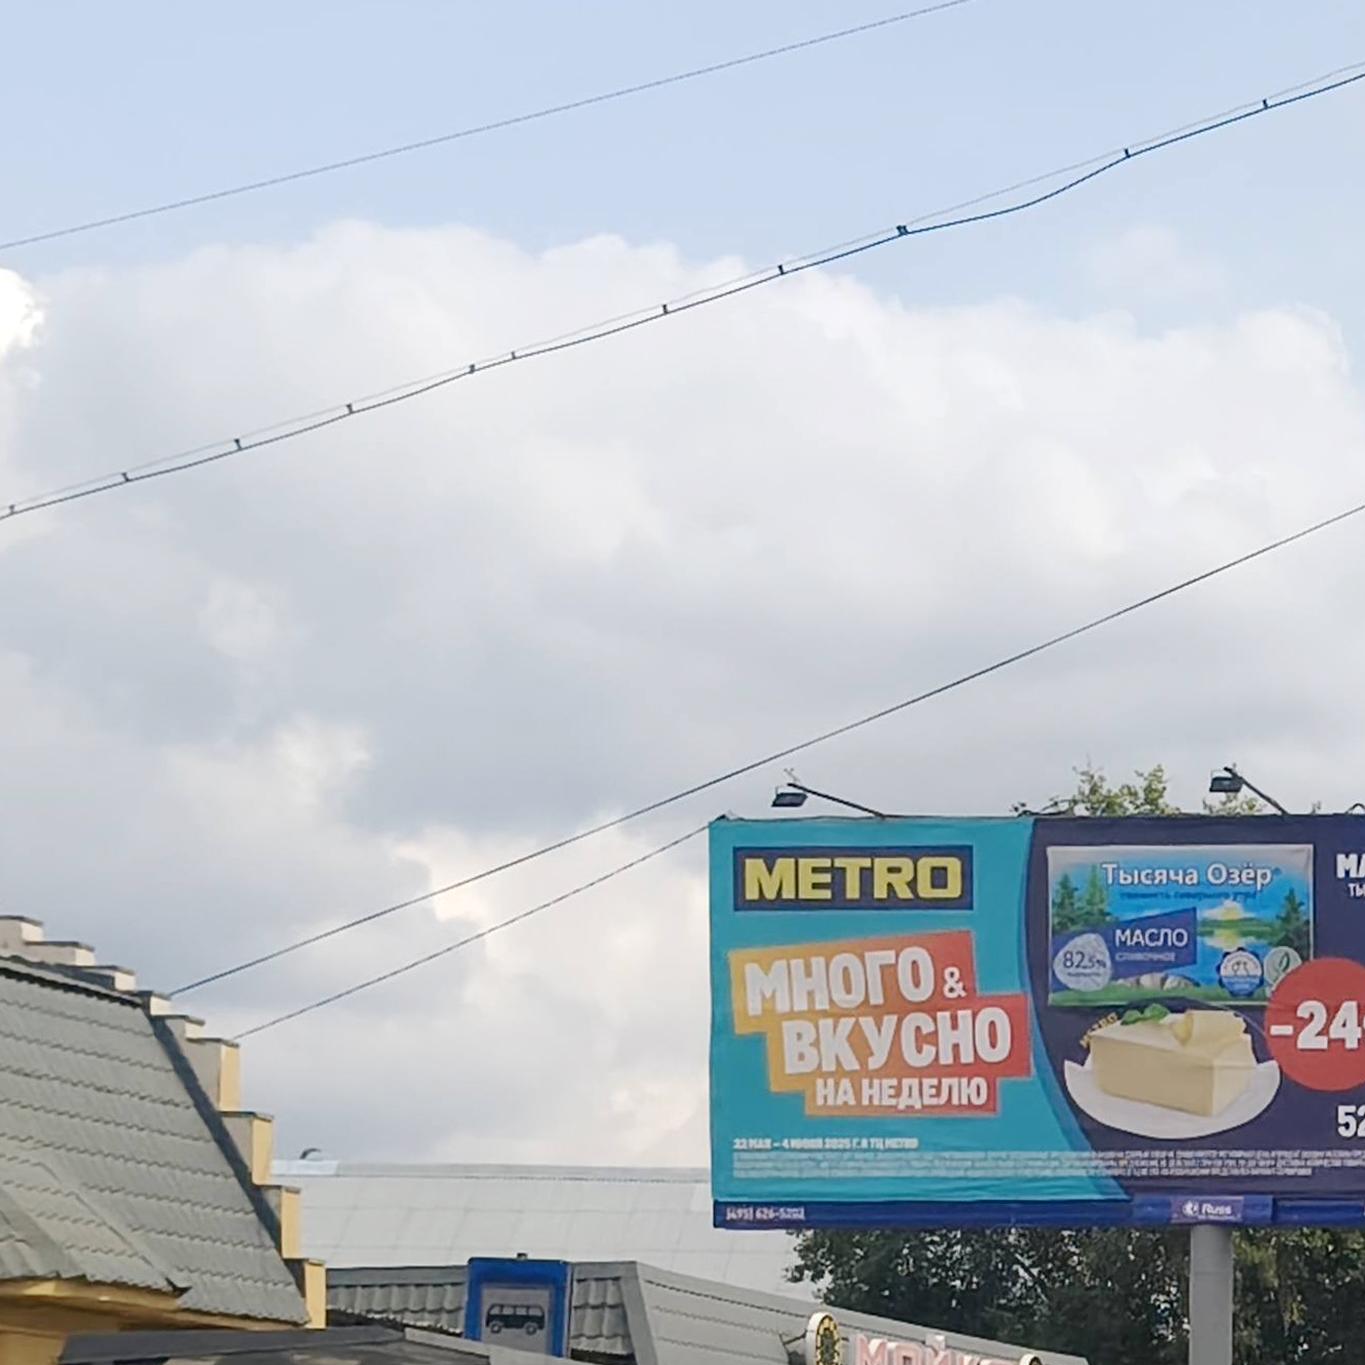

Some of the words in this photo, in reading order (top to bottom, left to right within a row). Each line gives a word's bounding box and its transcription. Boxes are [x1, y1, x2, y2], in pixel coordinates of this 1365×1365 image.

[744, 856, 962, 901] METRO
[1101, 862, 1198, 885] Тысяча
[1206, 861, 1273, 891] Озёр
[1114, 927, 1189, 948] МАСЛО
[744, 946, 935, 1017] МНОГО
[943, 966, 967, 998] &
[782, 1007, 1012, 1075] ВКУСНО
[815, 1078, 857, 1107] НА
[861, 1076, 988, 1111] НЕДЕЛЮ
